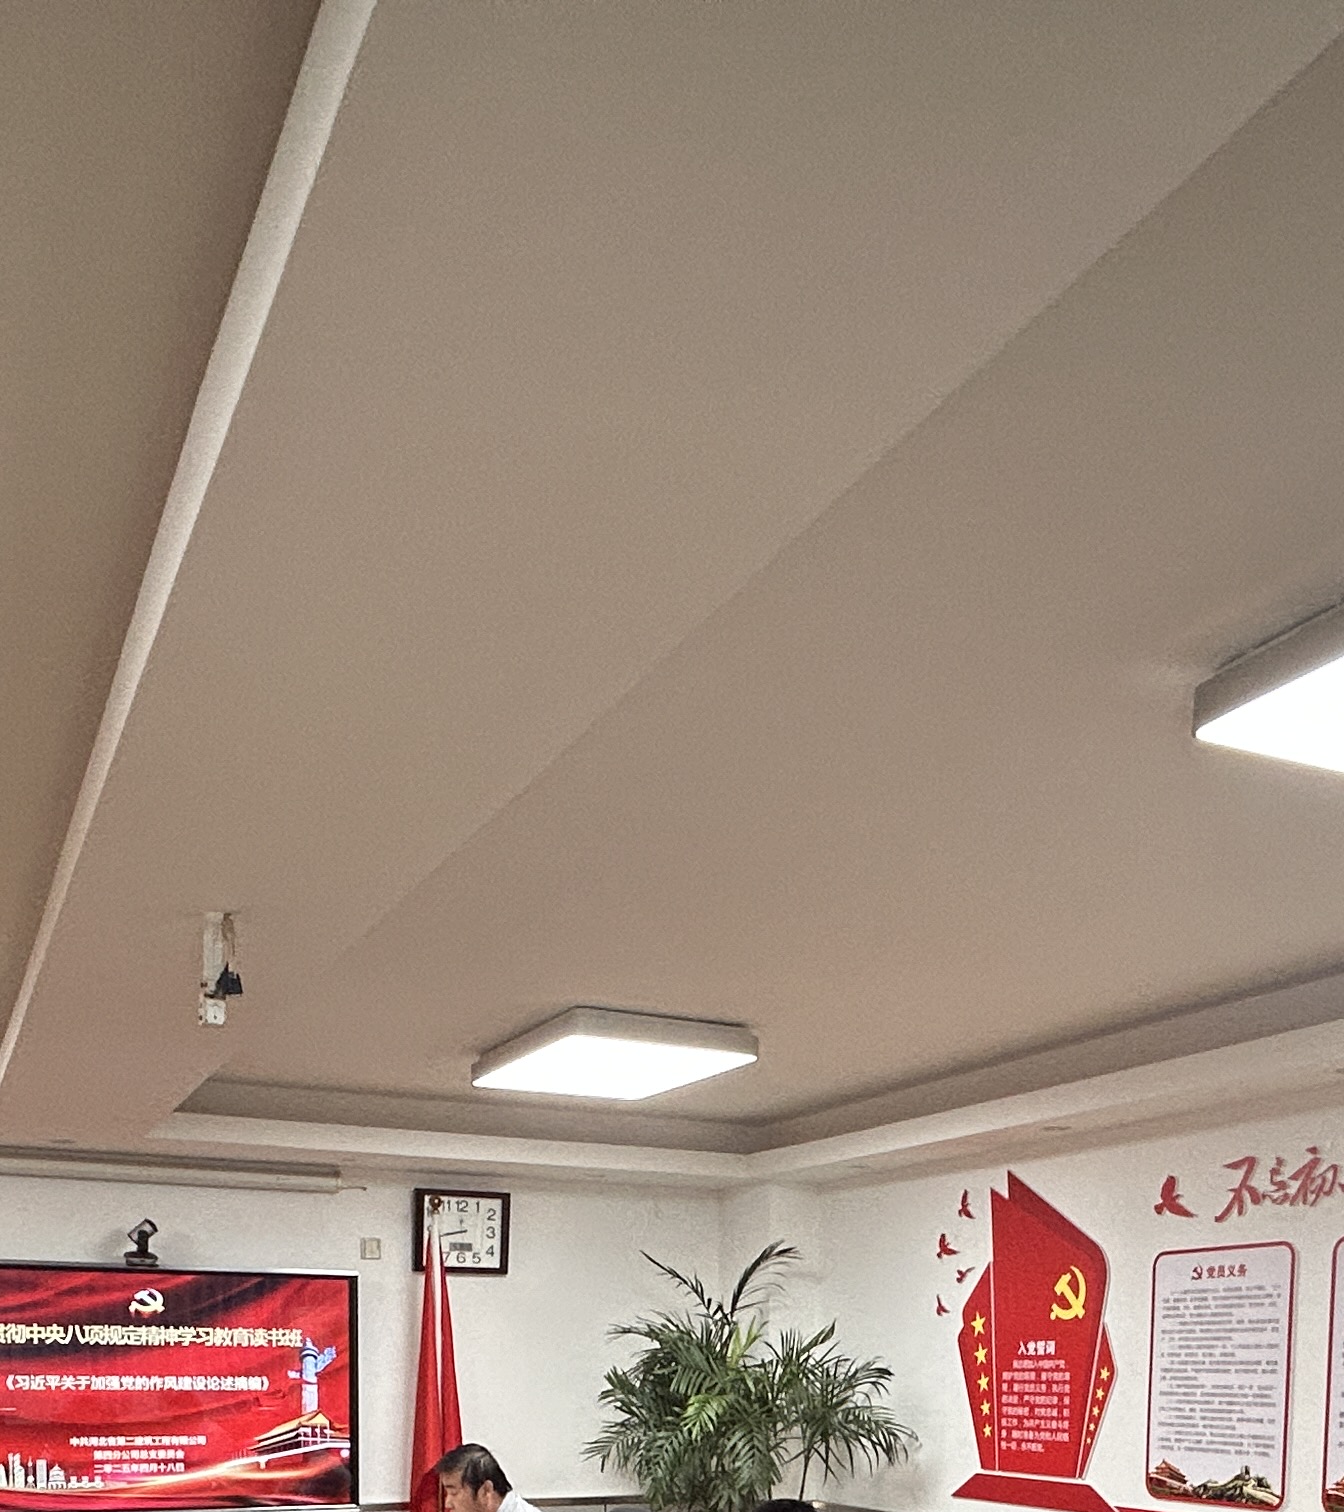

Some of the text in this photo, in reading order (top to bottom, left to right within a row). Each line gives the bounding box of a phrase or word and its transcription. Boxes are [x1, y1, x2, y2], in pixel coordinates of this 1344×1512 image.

[455, 1200, 469, 1213] 12
[487, 1208, 496, 1221] 2
[486, 1226, 496, 1239] 3
[486, 1245, 495, 1257] 4
[442, 1252, 451, 1263] 7
[456, 1252, 466, 1264] 6
[472, 1253, 482, 1264] 5
[1206, 1264, 1248, 1279] 党员义务
